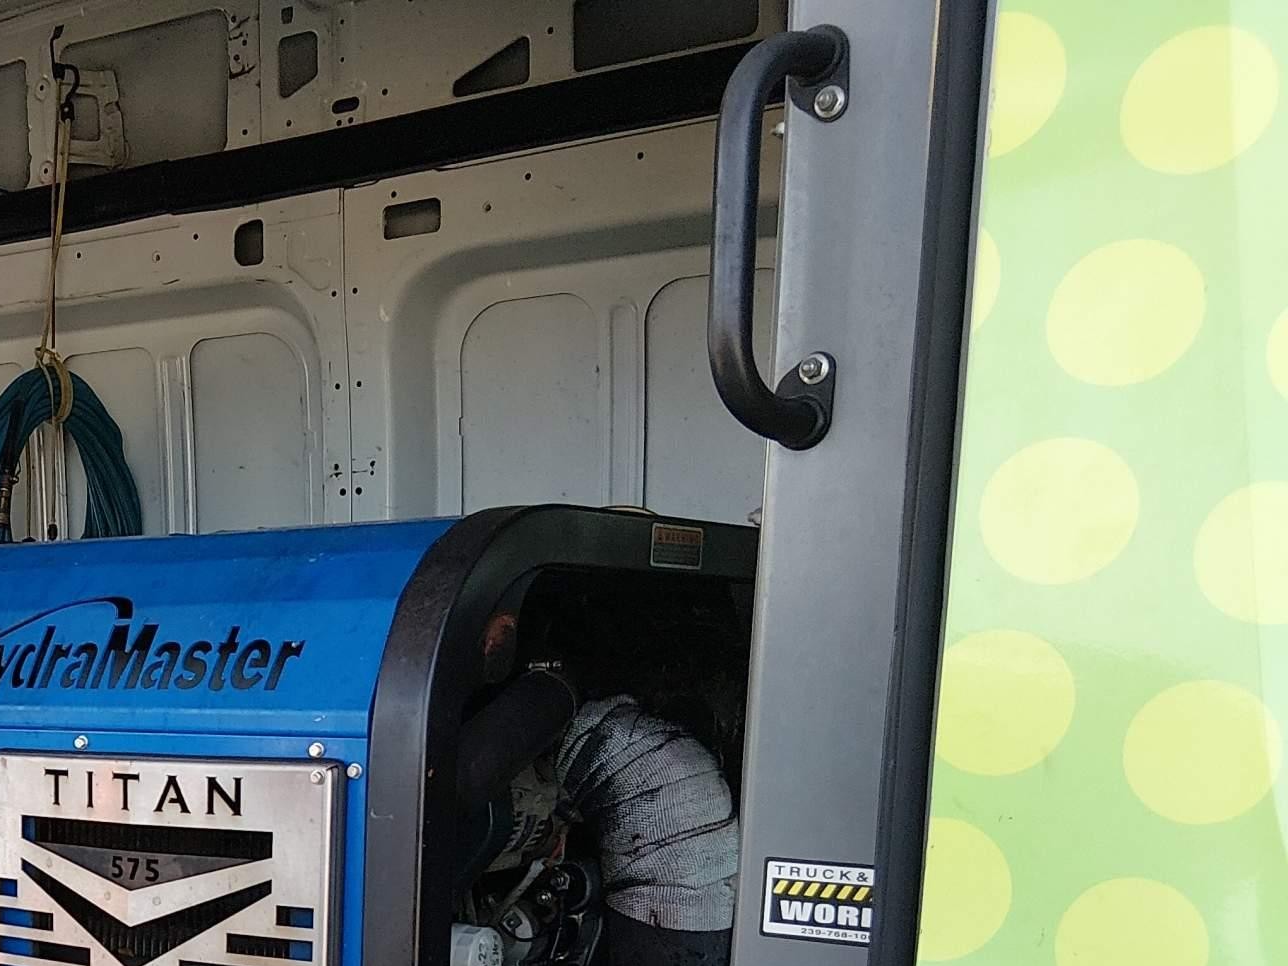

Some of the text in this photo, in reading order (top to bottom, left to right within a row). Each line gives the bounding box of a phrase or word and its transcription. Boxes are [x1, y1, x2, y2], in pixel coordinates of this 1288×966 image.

[44, 768, 243, 817] TITAN
[111, 855, 161, 883] 575
[800, 927, 870, 941] 239-768-10
